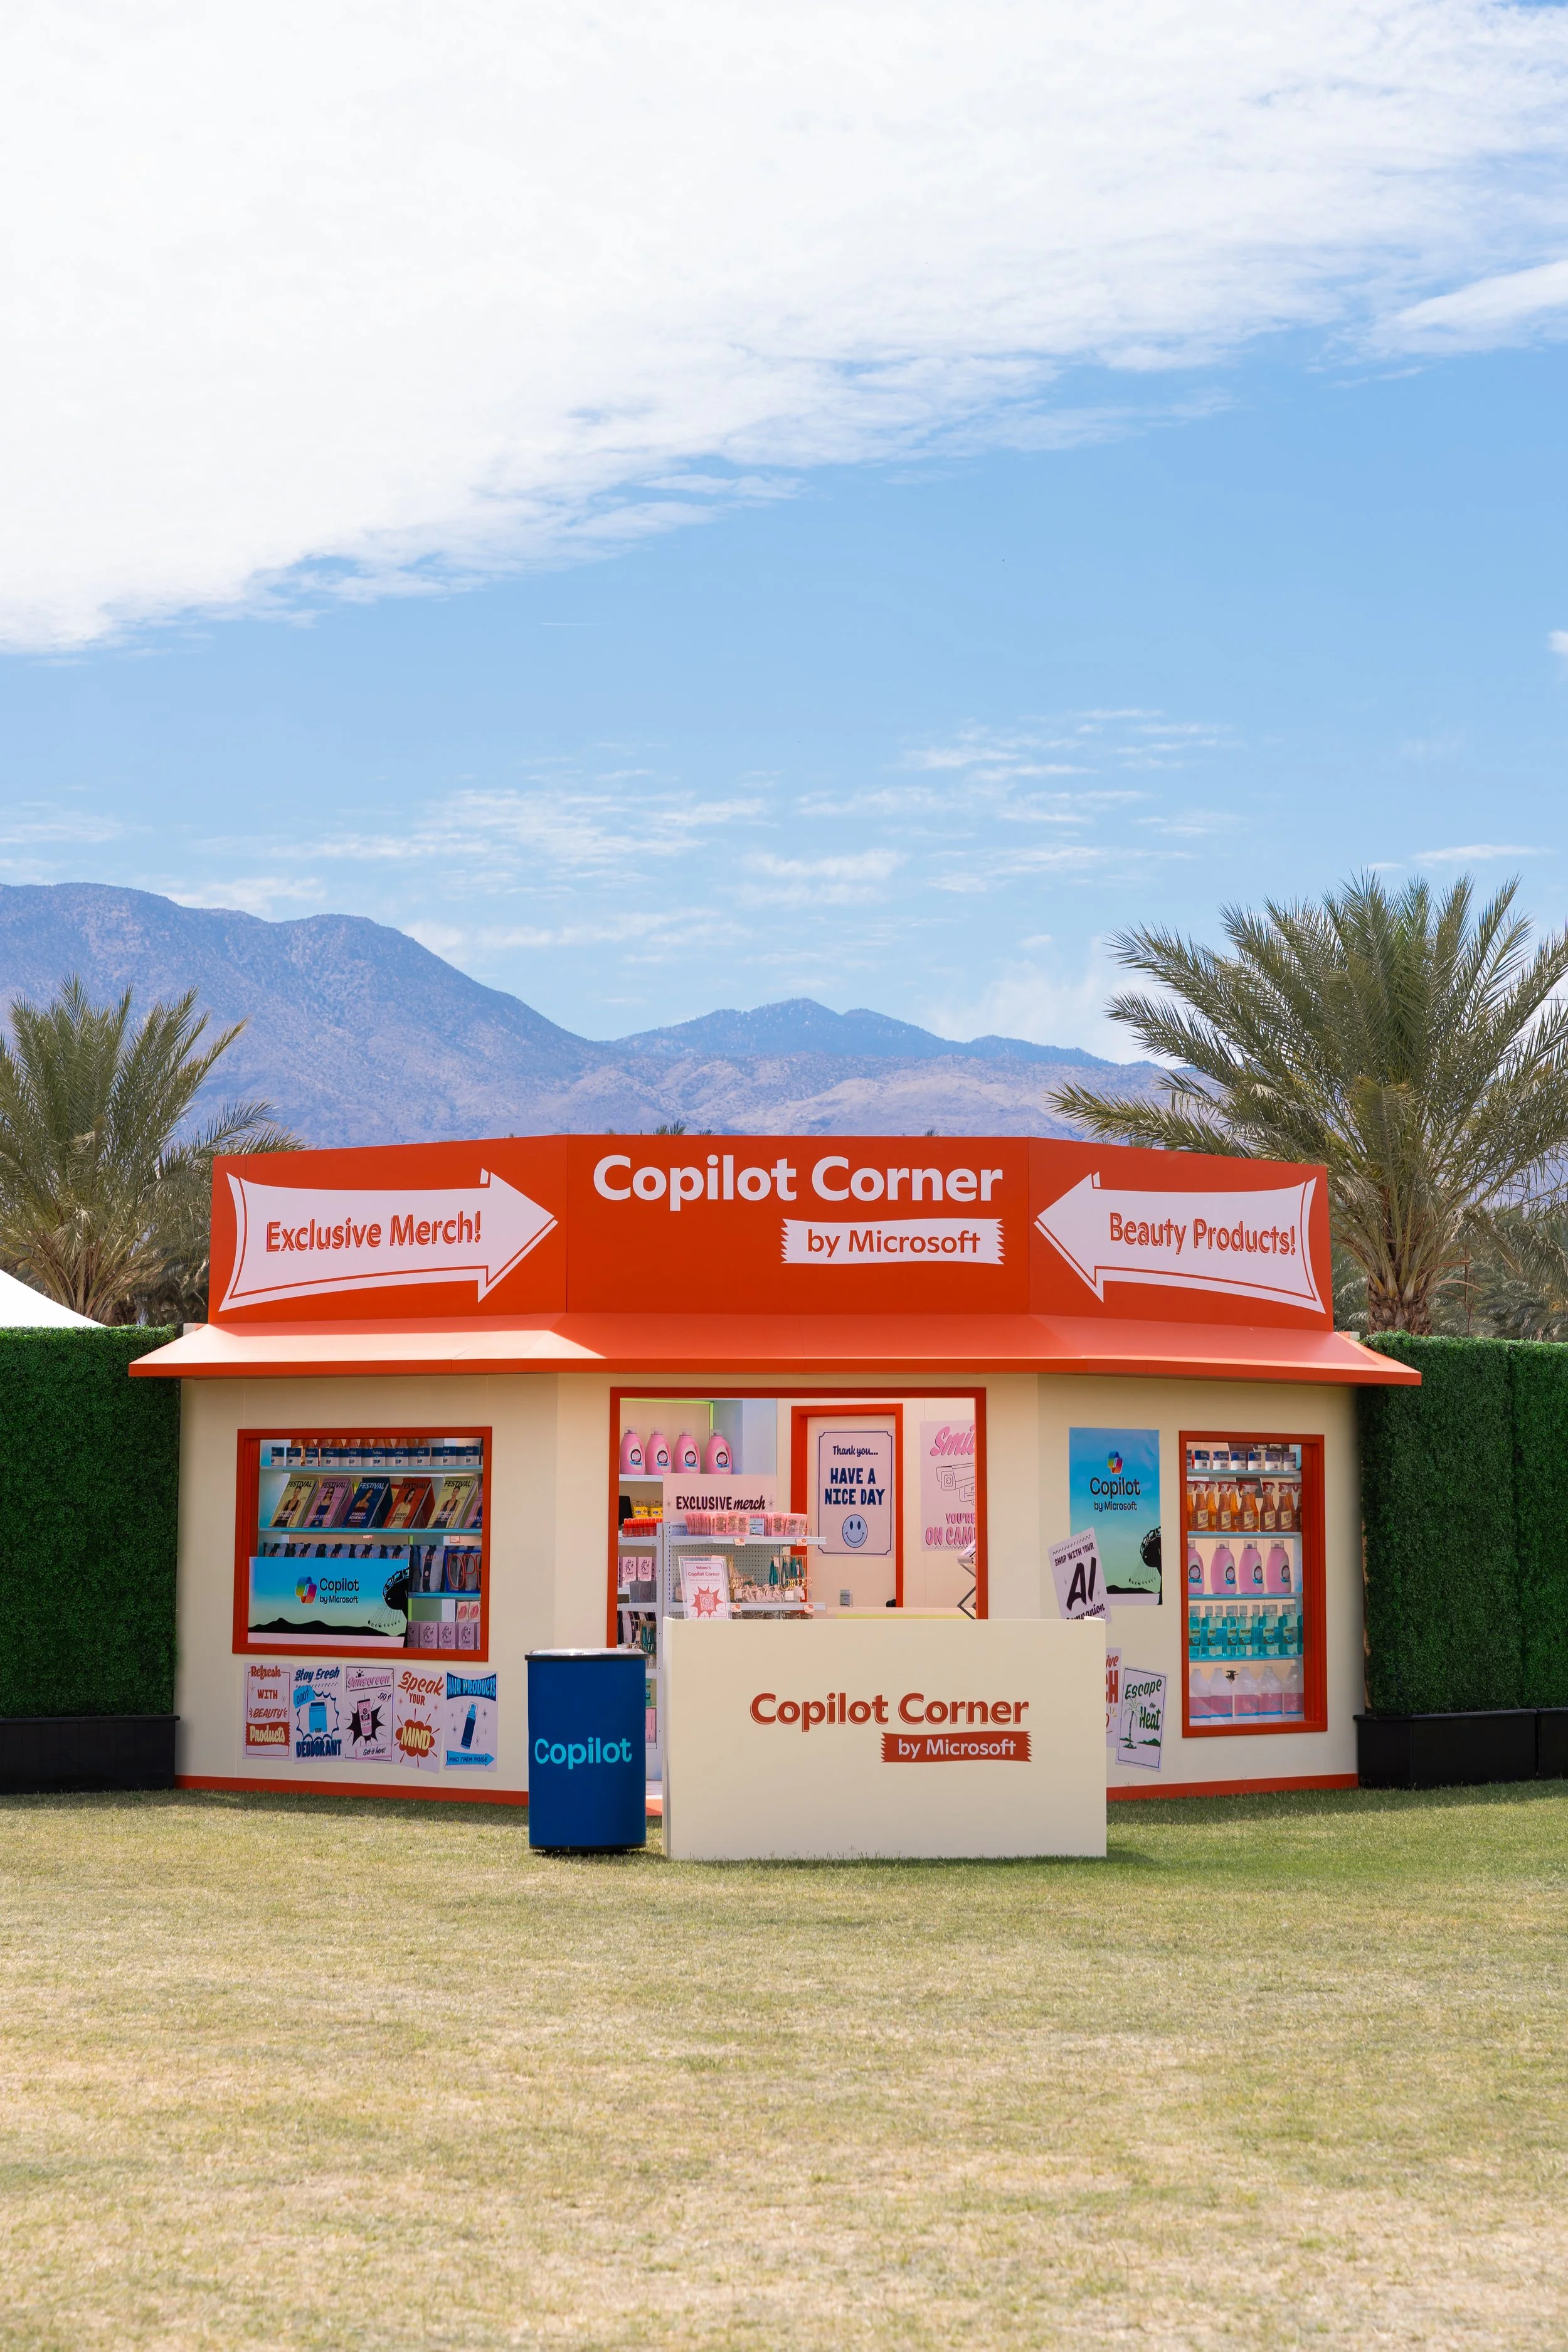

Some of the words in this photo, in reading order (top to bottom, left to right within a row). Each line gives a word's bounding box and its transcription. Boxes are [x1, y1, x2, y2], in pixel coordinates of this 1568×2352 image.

[593, 1154, 797, 1212] Copilot
[812, 1156, 1004, 1202] Corner
[267, 1217, 381, 1253] Exclusive
[389, 1210, 481, 1246] Merch!
[1110, 1212, 1187, 1255] Beauty
[1193, 1218, 1296, 1256] Products!
[808, 1229, 839, 1258] by
[848, 1230, 981, 1254] Microsoft
[832, 1445, 856, 1455] Thank
[830, 1468, 863, 1484] HAVE
[867, 1468, 876, 1484] A
[824, 1488, 856, 1505] NICE
[861, 1488, 886, 1505] DAY
[1090, 1476, 1141, 1499] Copilot
[676, 1496, 732, 1510] EXCLUSIVE
[733, 1495, 766, 1510] merch
[1094, 1501, 1103, 1512] by
[1104, 1501, 1137, 1510] Microsoft
[925, 1526, 943, 1545] ON
[946, 1526, 976, 1545] CAM
[1054, 1554, 1066, 1567] SHOP
[1067, 1548, 1083, 1561] WITH
[1082, 1542, 1094, 1554] YOUR
[319, 1578, 359, 1594] Copilot
[1066, 1556, 1096, 1611] AI
[319, 1595, 327, 1604] by
[329, 1595, 359, 1604] Microsoft
[250, 1665, 282, 1680] Refresh
[294, 1668, 314, 1683] Stay
[314, 1666, 341, 1680] Fresh
[399, 1671, 444, 1696] Speak
[447, 1676, 461, 1695] HAIR
[462, 1678, 495, 1697] PRODUCTS
[1125, 1678, 1162, 1700] Escape
[257, 1689, 278, 1699] WITH
[409, 1693, 425, 1706] YOUR
[253, 1708, 283, 1719] BEAUTY
[750, 1692, 889, 1732] Copilot
[898, 1692, 1029, 1725] Corner
[1139, 1706, 1162, 1731] Heat
[250, 1725, 285, 1743] Products
[401, 1726, 431, 1751] MIND
[295, 1739, 342, 1758] DEODORANT
[534, 1737, 632, 1769] Copilot
[898, 1739, 921, 1759] by
[926, 1739, 1016, 1756] Microsoft
